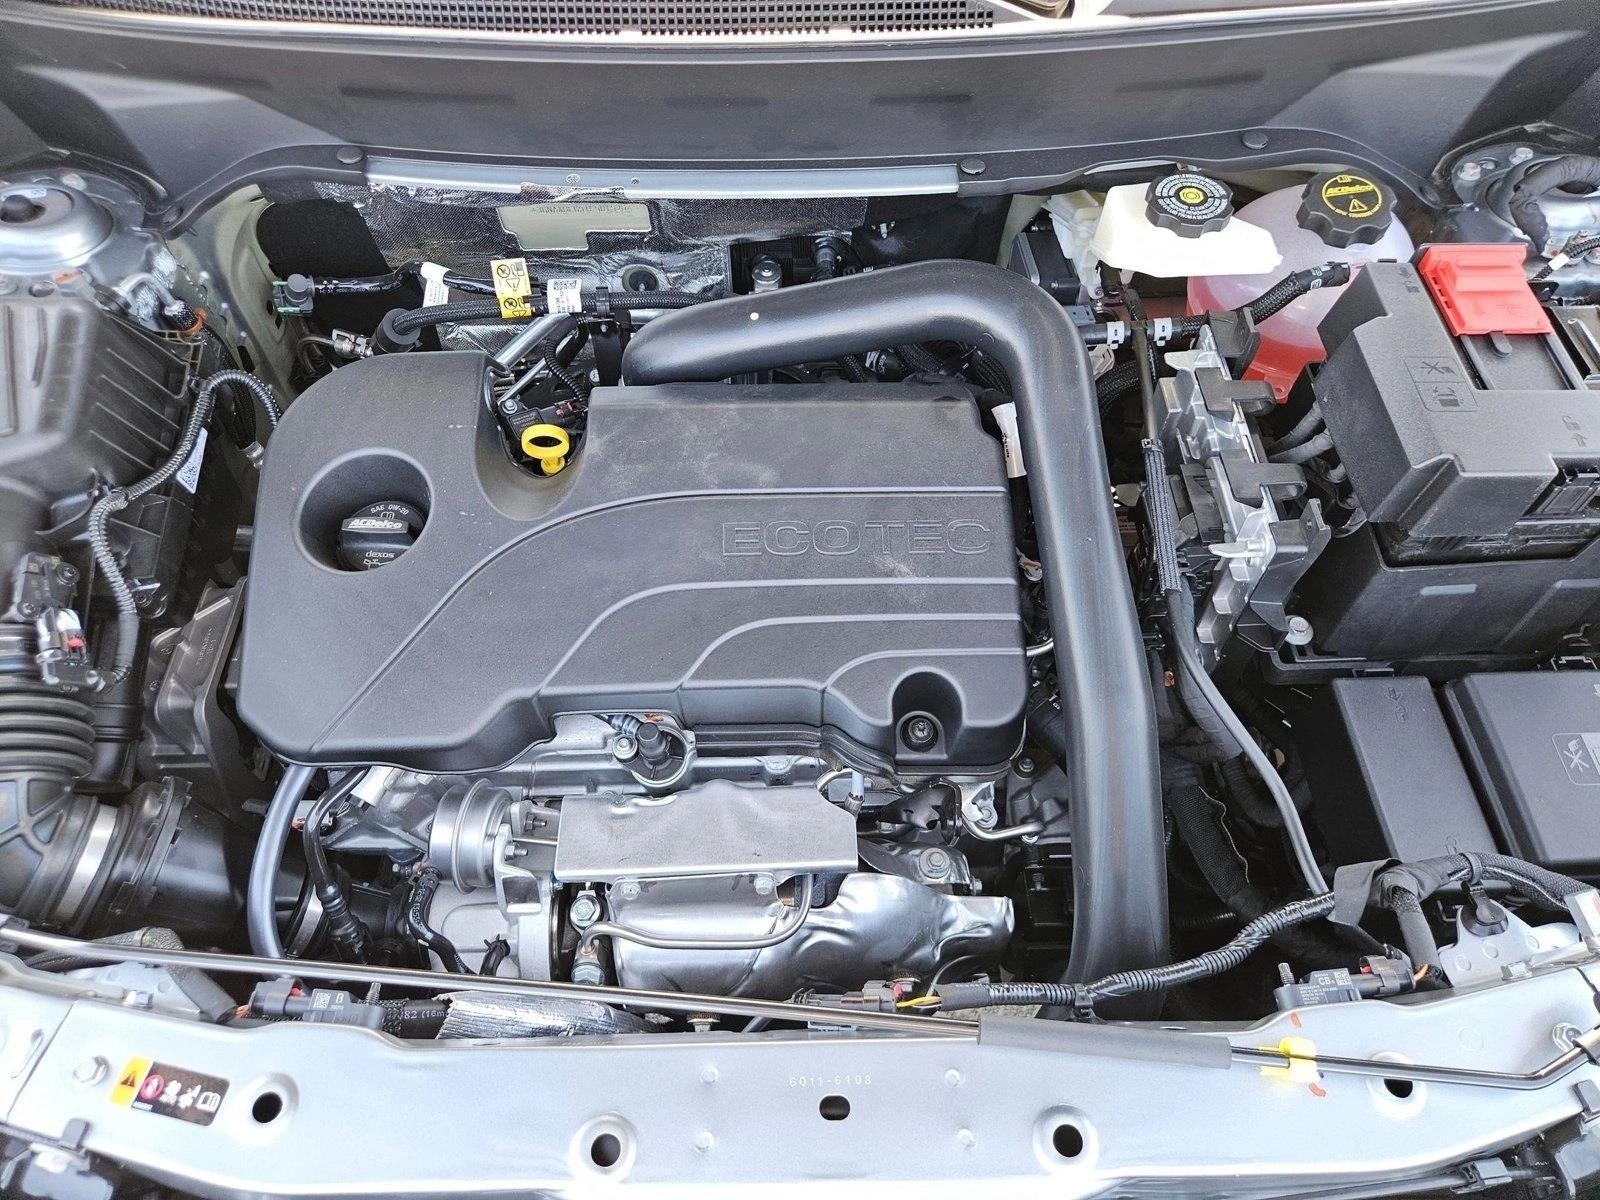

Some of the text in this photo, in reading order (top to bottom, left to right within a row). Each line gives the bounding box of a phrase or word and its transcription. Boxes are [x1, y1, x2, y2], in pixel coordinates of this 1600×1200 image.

[370, 504, 409, 516] SAE 0W-20
[348, 518, 403, 529] ACDelco
[722, 519, 991, 555] ECOTEC
[365, 550, 396, 559] dexos
[1318, 976, 1331, 986] CB
[788, 1074, 872, 1088] 6011-6108
